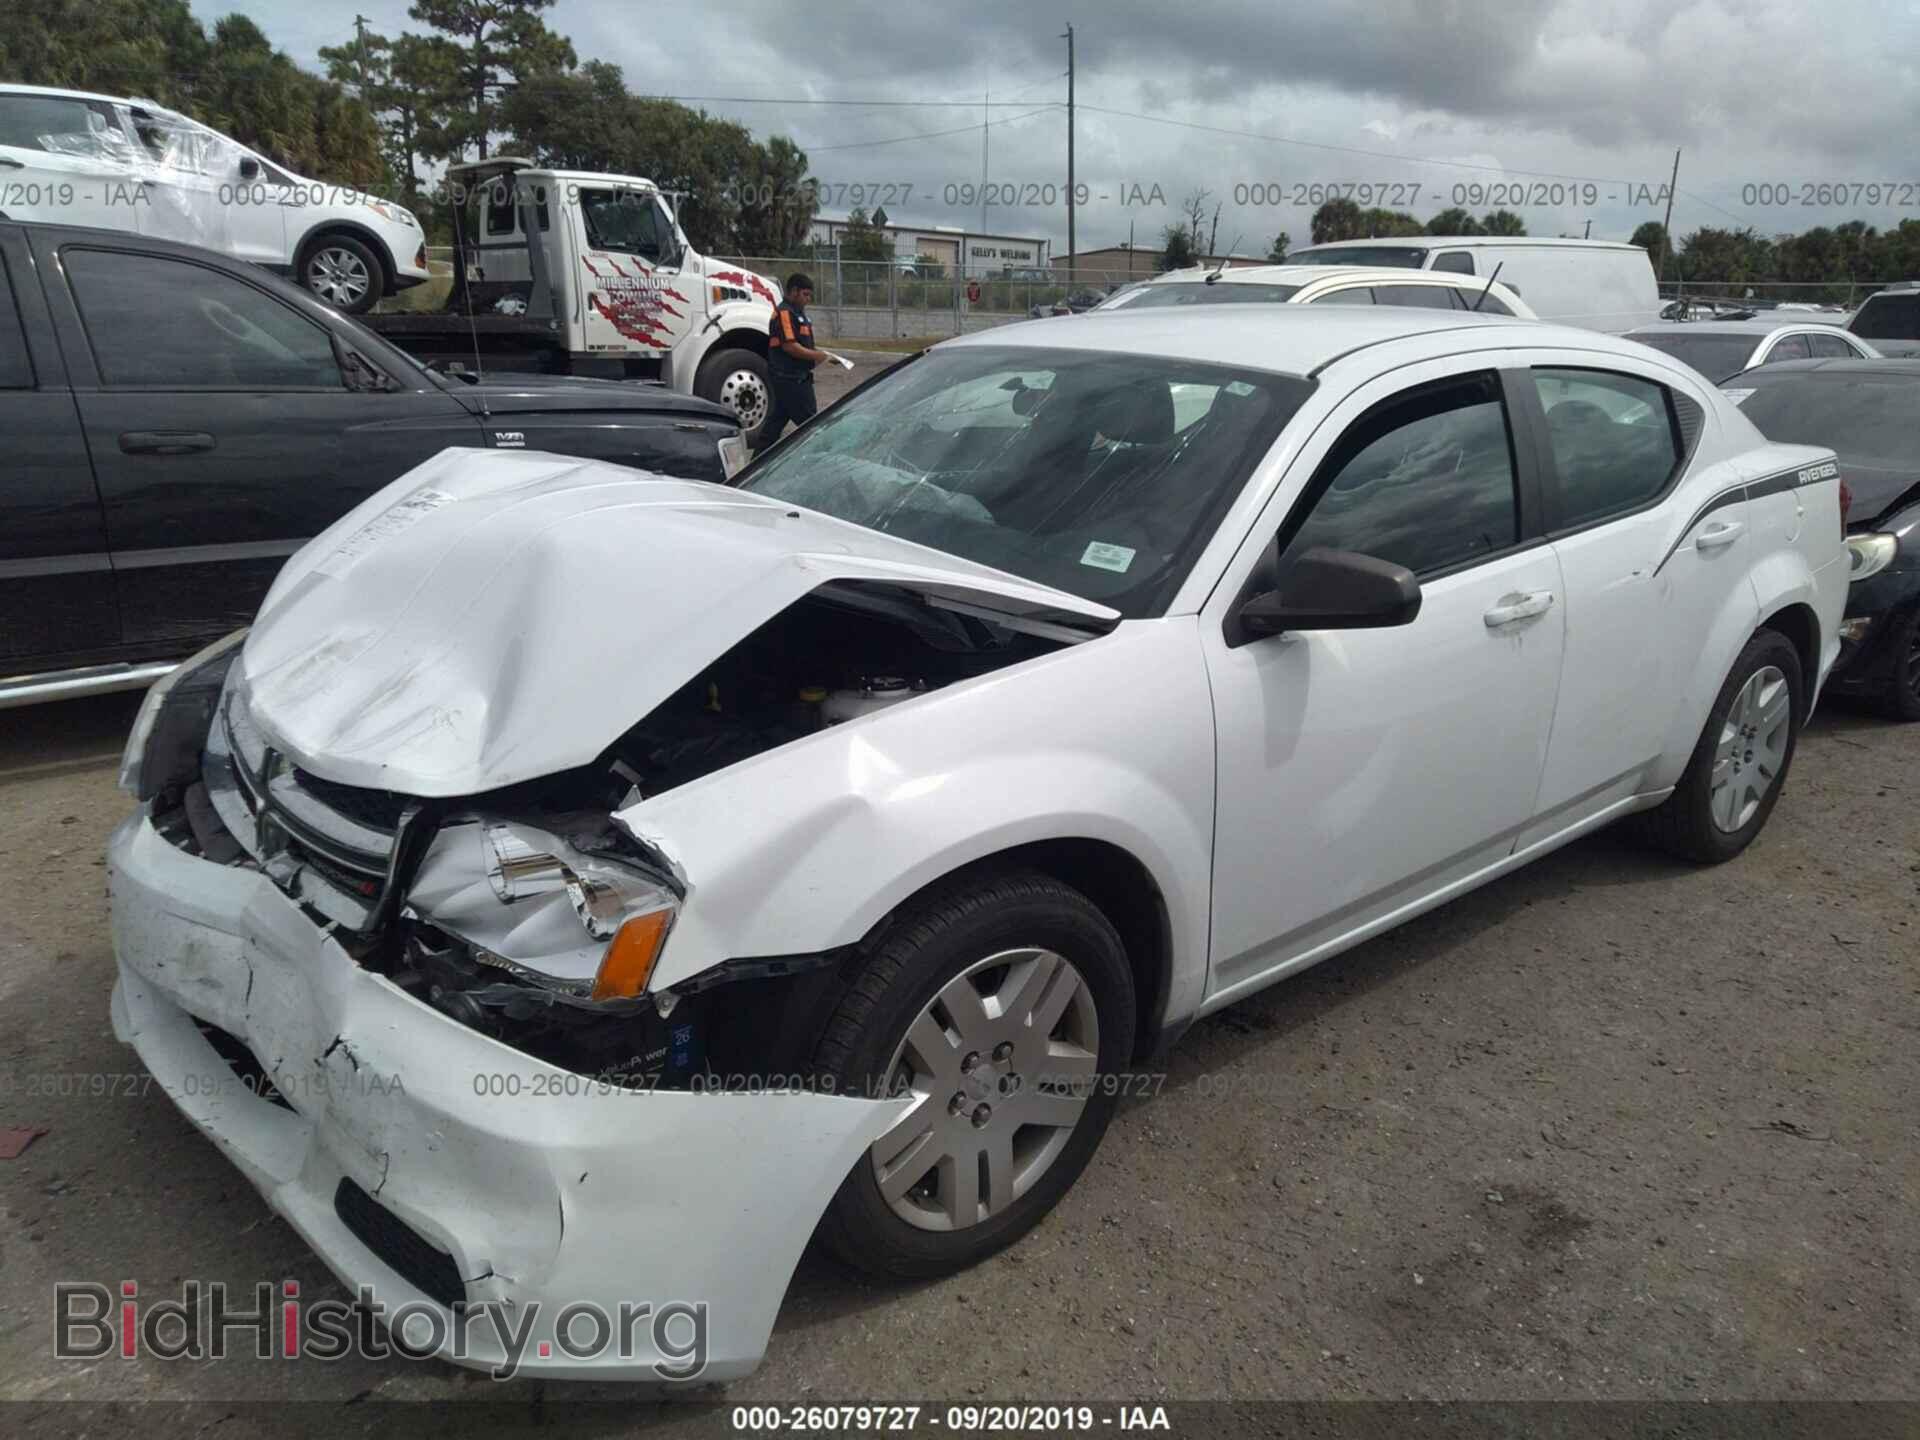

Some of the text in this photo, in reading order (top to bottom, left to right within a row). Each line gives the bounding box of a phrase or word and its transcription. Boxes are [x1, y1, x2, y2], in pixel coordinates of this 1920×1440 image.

[595, 275, 672, 290] MILLENNIUM
[609, 289, 662, 303] TOWING
[1798, 462, 1837, 485] AVENGER
